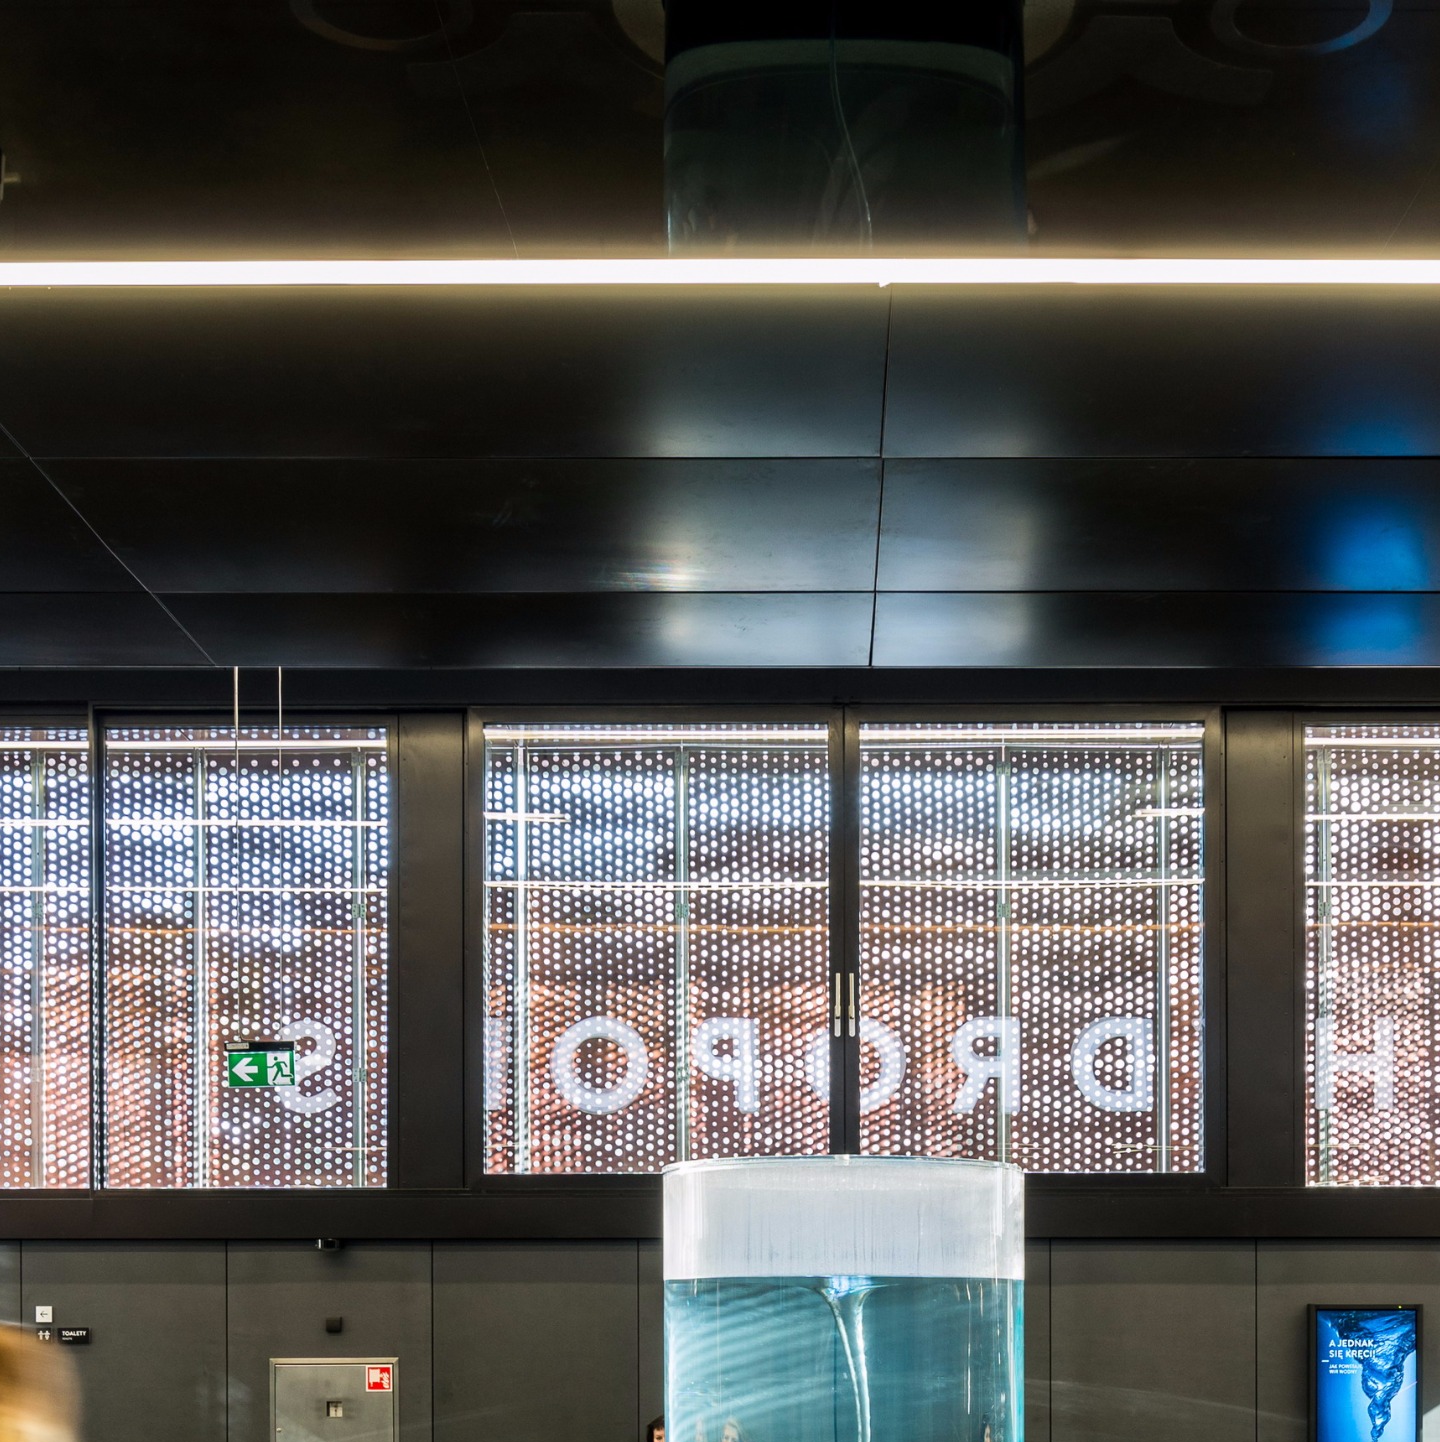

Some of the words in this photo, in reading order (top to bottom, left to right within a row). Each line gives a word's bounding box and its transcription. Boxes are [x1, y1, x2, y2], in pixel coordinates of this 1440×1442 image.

[1329, 1339, 1336, 1347] A
[1329, 1350, 1343, 1359] SIĘ
[1345, 1350, 1375, 1359] KRĘCI!
